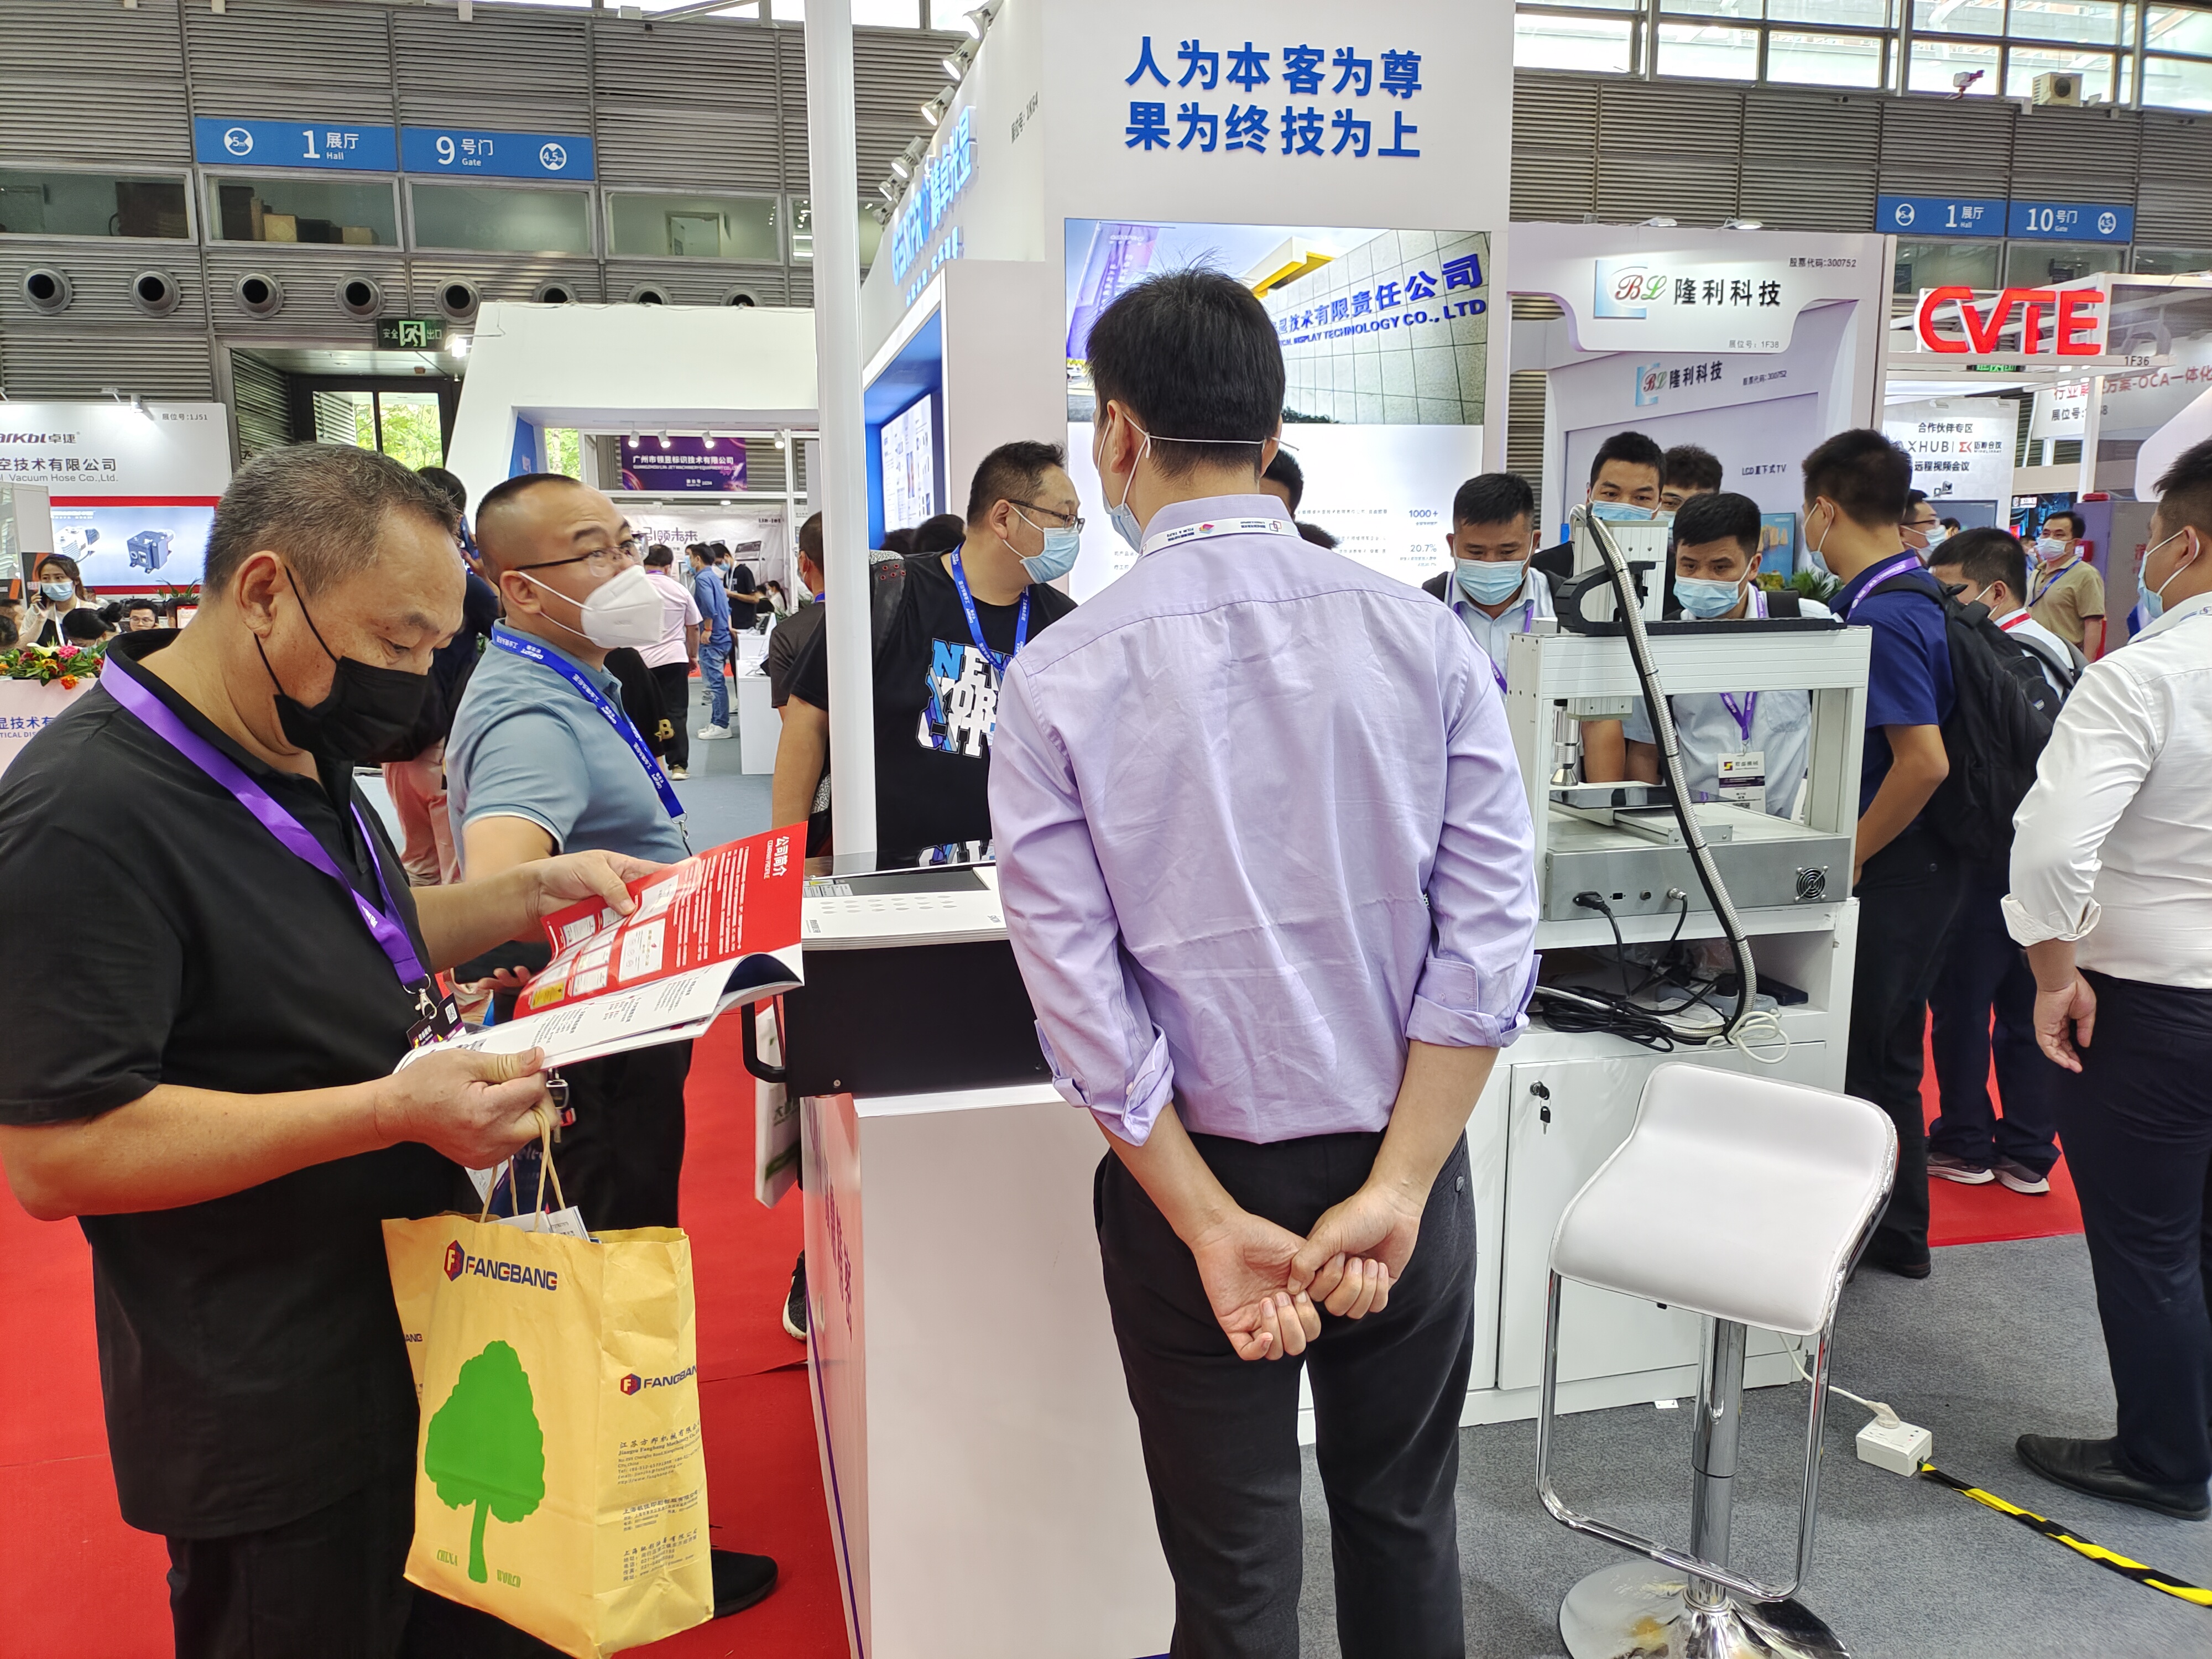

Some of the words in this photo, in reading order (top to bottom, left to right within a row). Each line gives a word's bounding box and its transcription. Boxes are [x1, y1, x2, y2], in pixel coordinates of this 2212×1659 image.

[303, 130, 320, 159] 1
[326, 132, 359, 149] 展厅
[326, 152, 344, 160] Hall
[436, 137, 455, 164] 9
[461, 138, 493, 155] 号门
[462, 158, 481, 166] Gate
[1945, 205, 1957, 227] 1
[1961, 206, 1984, 220] 展厅
[2026, 208, 2053, 232] 10
[2056, 210, 2078, 223] 号门
[1673, 278, 1781, 307] 隆利科技
[1324, 316, 1400, 340] TECHNOLOGY
[1443, 299, 1486, 319] LTD
[1919, 286, 2105, 355] CVTE
[427, 328, 442, 340] 出口
[2124, 356, 2150, 366] 1F36
[1669, 361, 1723, 389] 隆利科技
[1918, 422, 1973, 434] 合作伙伴专区
[1914, 461, 1970, 472] 远程视频会议
[773, 836, 789, 877] 公司简介
[466, 1255, 558, 1291] FANGBANG
[497, 1569, 521, 1588] WORLD
